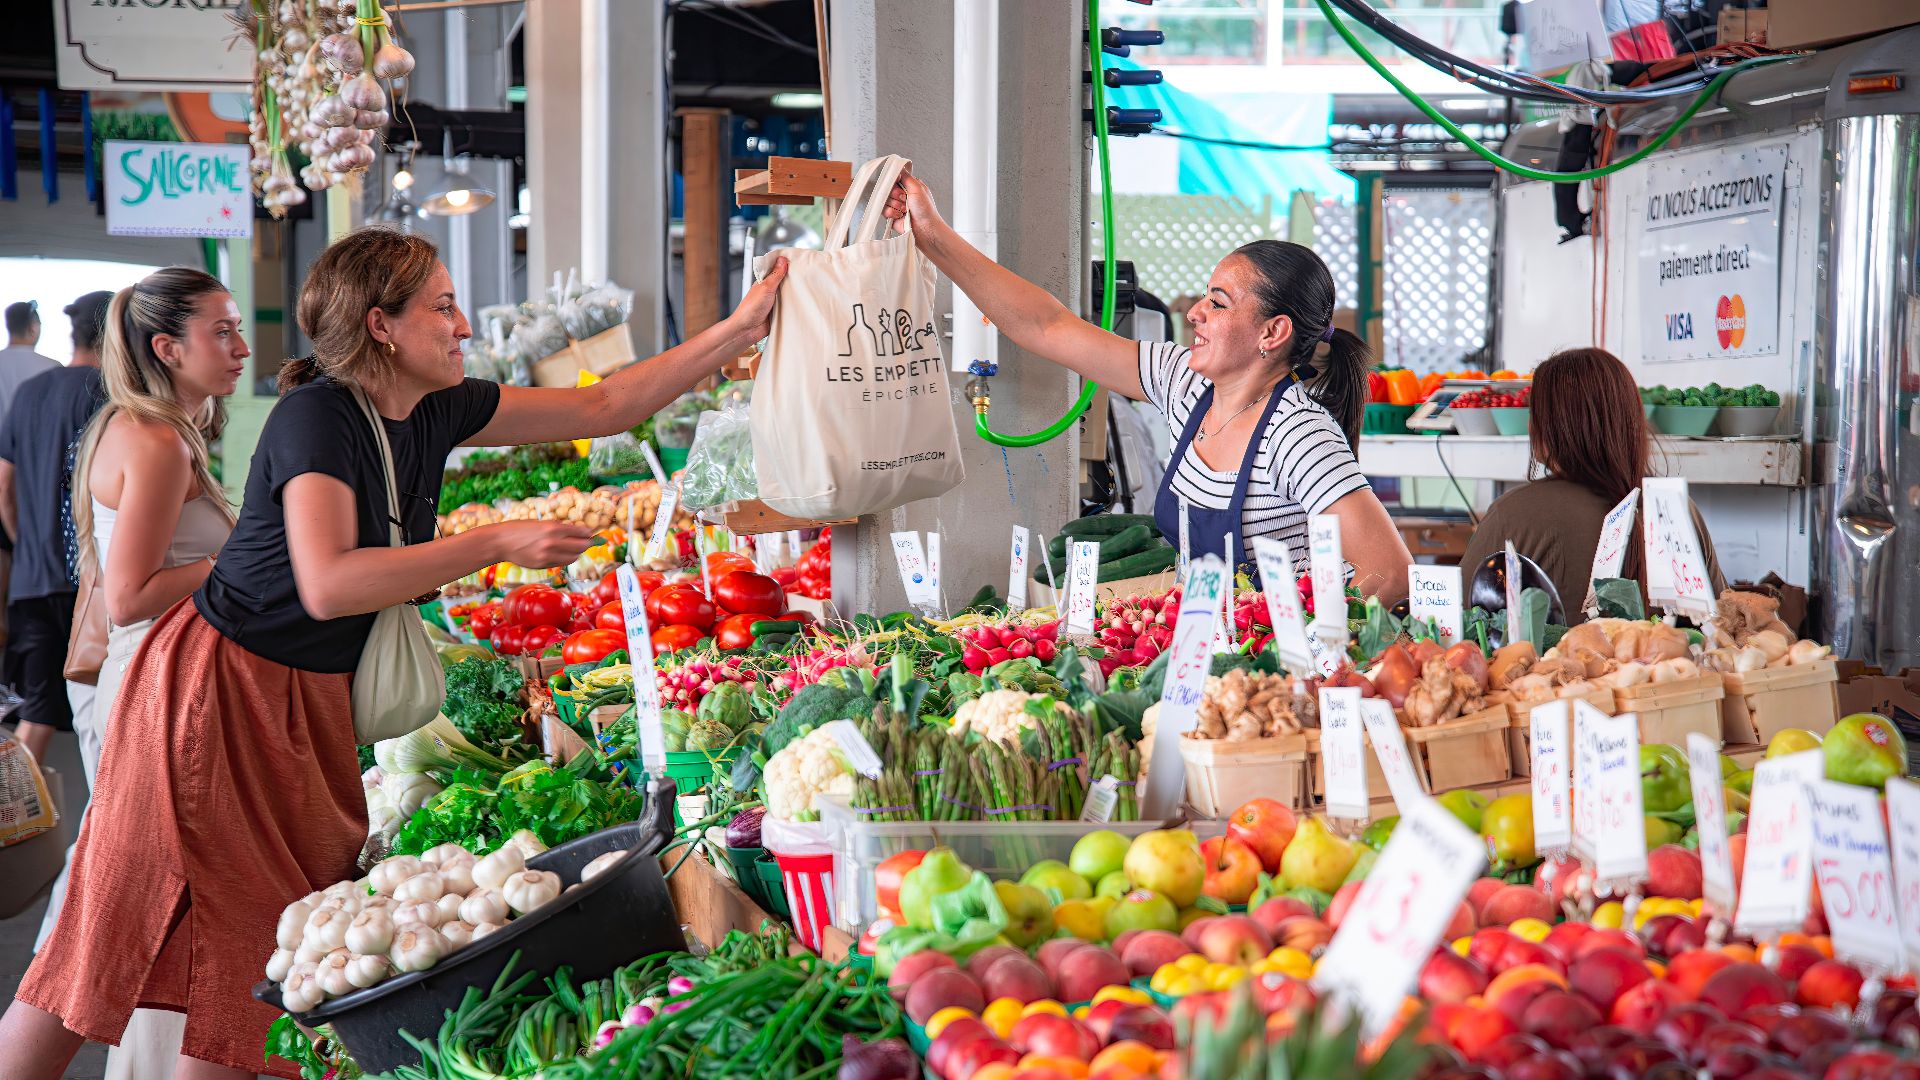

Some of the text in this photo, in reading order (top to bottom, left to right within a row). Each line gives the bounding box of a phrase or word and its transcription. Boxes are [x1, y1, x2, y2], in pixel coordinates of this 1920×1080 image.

[120, 149, 242, 206] SALICORNE
[1646, 173, 1773, 222] ICI NOUS ACCEPTONS
[1659, 243, 1750, 286] paiement direct
[1665, 311, 1694, 341] VISA
[826, 366, 864, 382] LES
